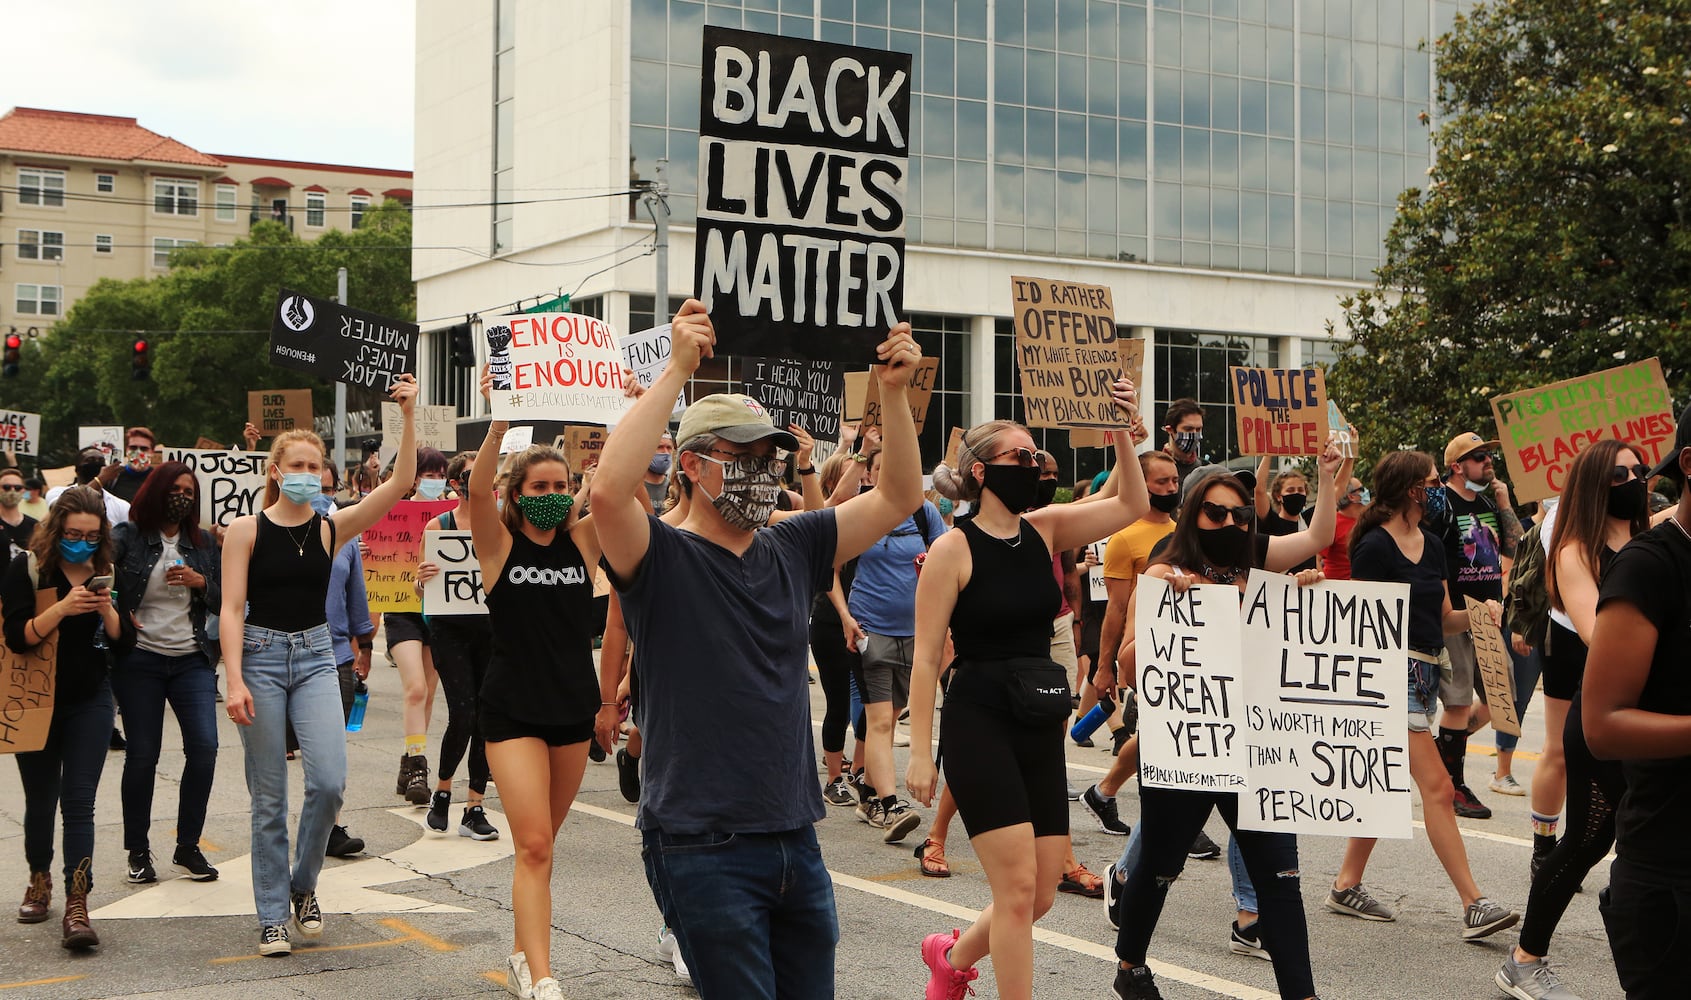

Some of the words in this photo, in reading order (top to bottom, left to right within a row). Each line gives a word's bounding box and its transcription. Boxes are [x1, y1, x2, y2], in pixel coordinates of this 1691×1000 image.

[712, 45, 906, 148] BLACK
[706, 142, 904, 232] LIVES
[701, 227, 901, 330] MATTER
[1015, 280, 1041, 304] I'D
[1050, 284, 1110, 310] RATHER
[340, 315, 409, 351] MATTER
[510, 316, 615, 350] ENOUGH
[1023, 308, 1117, 344] OFFEND
[275, 345, 316, 364] #ENOUGH
[357, 345, 407, 373] LIVES
[558, 343, 574, 357] IS
[1021, 344, 1041, 366] MY
[1044, 345, 1072, 363] WHITE
[1075, 348, 1117, 365] FRIENDS
[515, 358, 623, 390] ENOUGH
[755, 363, 765, 381] I
[771, 365, 802, 388] HEAR
[807, 369, 831, 394] YOU
[1024, 369, 1064, 387] THAN
[1236, 368, 1318, 410] POLICE
[508, 392, 628, 411] #BLACKLIVESMATTER
[759, 383, 794, 407] STAND
[797, 390, 818, 410] WITH
[821, 394, 841, 415] YOU
[1026, 396, 1049, 421] MY
[1497, 375, 1606, 426] PROPERTY
[1610, 363, 1654, 394] CAN
[0, 412, 27, 426] ACK
[262, 408, 285, 418] LIVES
[263, 418, 295, 431] MATTER
[790, 411, 811, 430] FOR
[813, 413, 838, 435] YOU
[1266, 407, 1290, 424] THE
[1242, 416, 1318, 454] POLICE
[1510, 418, 1545, 449] BE
[1518, 428, 1604, 473] BLACK
[1612, 412, 1674, 443] LIVES
[365, 569, 396, 582] There
[1157, 584, 1205, 627] ARE
[1247, 581, 1270, 629] A
[1283, 584, 1404, 650] HUMAN
[1467, 599, 1488, 652] LIVES
[1150, 628, 1202, 667] WE
[1280, 649, 1385, 699] LIFE
[1479, 657, 1500, 709] THEIR
[1483, 612, 1516, 725] MATTERED
[0, 659, 28, 745] HOUSE
[1142, 664, 1234, 718] GREAT
[1166, 721, 1236, 758] YET?
[1246, 705, 1264, 732] IS
[1269, 707, 1324, 737] WORTH
[1332, 717, 1385, 741] MORE
[1245, 744, 1282, 768] THAN
[1289, 748, 1299, 767] A
[1256, 787, 1362, 823] PERIOD.
